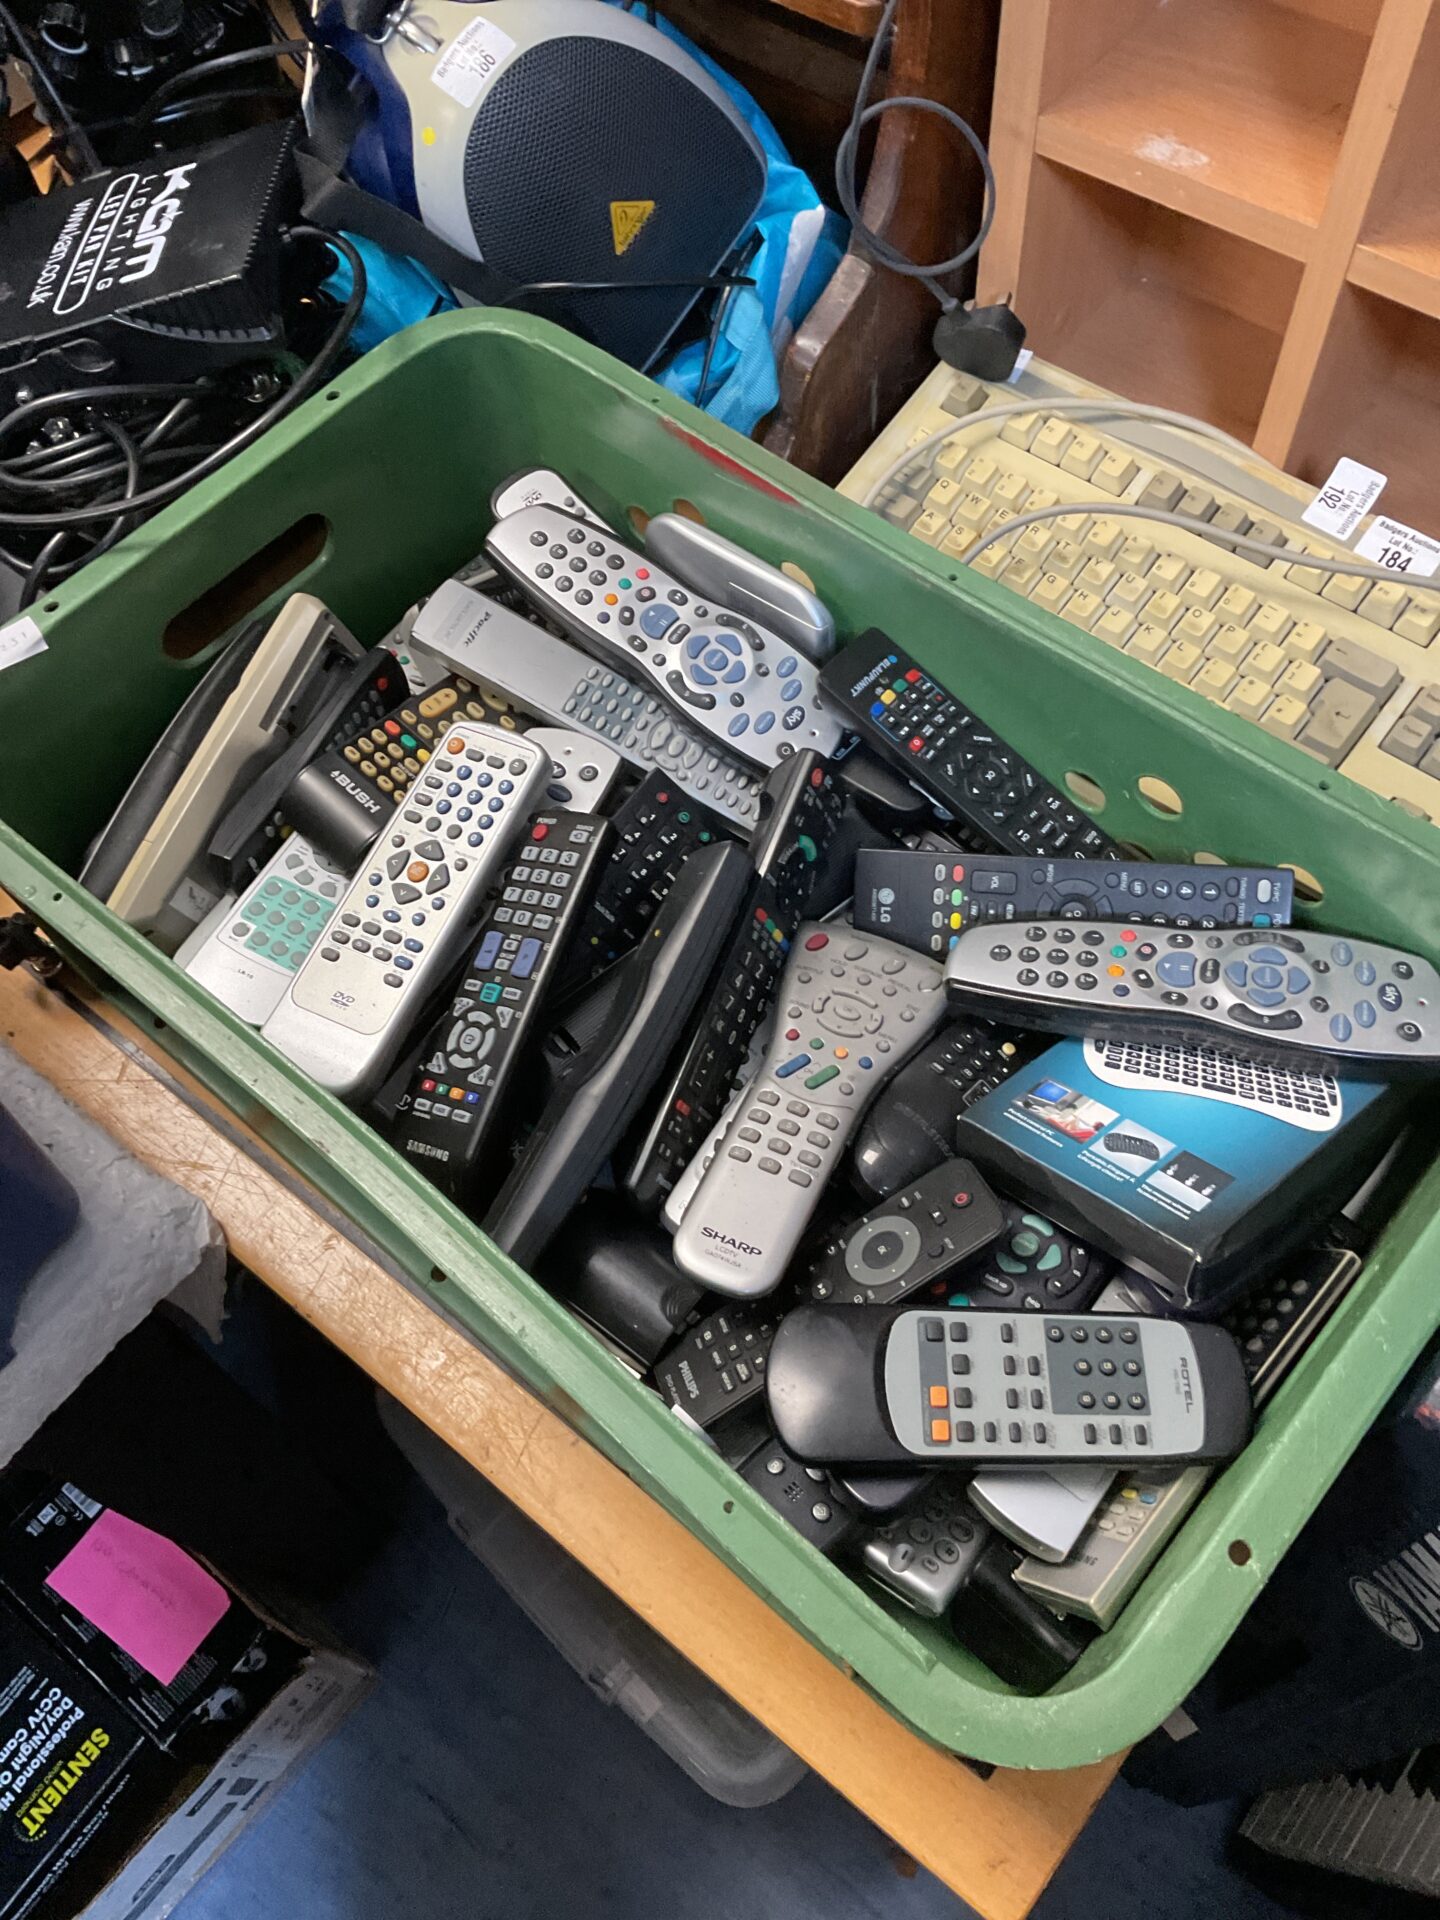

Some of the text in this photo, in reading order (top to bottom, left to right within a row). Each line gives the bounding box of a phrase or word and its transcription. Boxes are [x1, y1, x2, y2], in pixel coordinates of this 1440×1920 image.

[469, 49, 496, 78] 186
[70, 194, 125, 285] LED PAR KIT
[96, 174, 159, 291] LIGHTING
[26, 198, 94, 308] www.kam.co.uk
[1318, 485, 1346, 510] 192
[1346, 489, 1360, 503] Lot
[1379, 520, 1440, 554] Badgers Auctions
[1388, 536, 1402, 548] Lot
[940, 480, 1236, 634] Q W E R T Y U I O P
[1377, 546, 1413, 573] 184
[924, 511, 935, 519] A
[955, 526, 965, 535] S
[1014, 557, 1025, 566] F
[1047, 574, 1057, 584] G
[1077, 592, 1089, 600] H
[1111, 609, 1120, 617] J
[1143, 625, 1154, 634] K
[1176, 643, 1185, 651] L
[850, 657, 892, 698] BLAUPUNKT
[785, 708, 802, 727] sky
[336, 772, 382, 814] BUSH
[526, 848, 573, 863] 1 2 3
[516, 868, 565, 884] 4 5 6
[990, 875, 1000, 889] VOL
[1120, 871, 1129, 892] MENU
[1156, 884, 1168, 894] 7
[509, 889, 556, 905] 7 8 9
[1176, 886, 1192, 927] 4 5
[517, 913, 526, 923] 0
[879, 906, 892, 923] LG
[1202, 920, 1215, 928] 2
[1382, 985, 1399, 1005] sky
[406, 1139, 450, 1162] SAMSUNG
[700, 1226, 762, 1256] SHARP
[678, 1360, 700, 1399] PHILIPS
[1179, 1356, 1194, 1414] ROTEL
[27, 1687, 62, 1730] CCTV
[10, 1696, 74, 1772] Day/Night
[12, 1706, 85, 1794] Professional
[21, 1727, 110, 1837] SENTIENT
